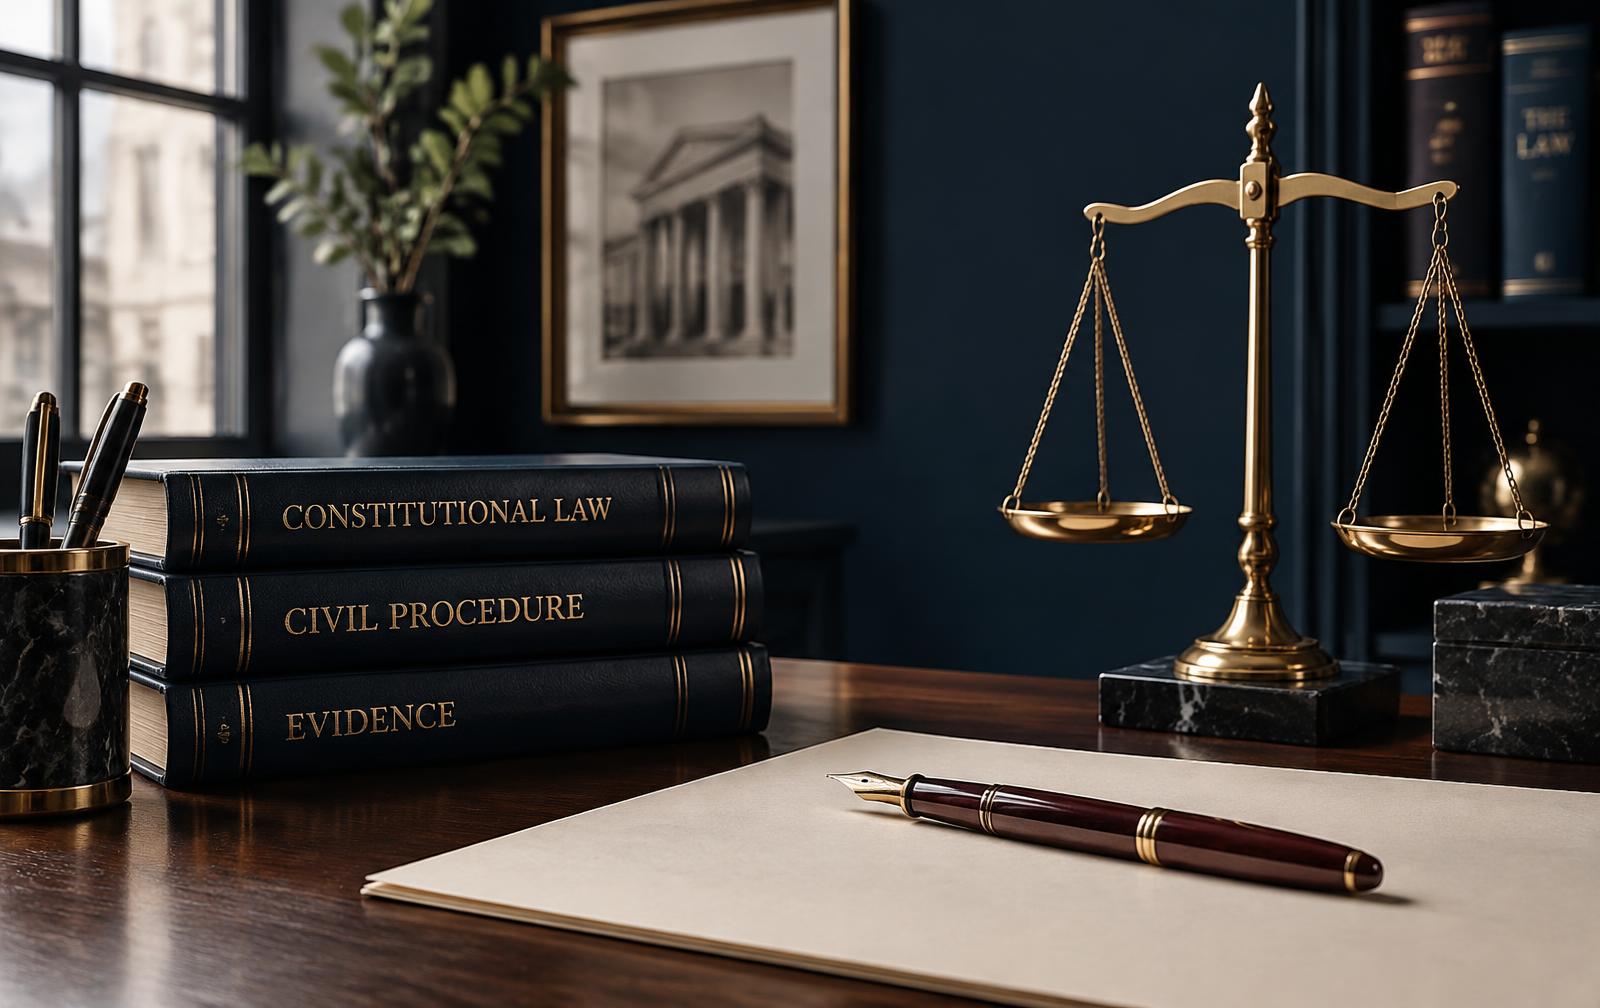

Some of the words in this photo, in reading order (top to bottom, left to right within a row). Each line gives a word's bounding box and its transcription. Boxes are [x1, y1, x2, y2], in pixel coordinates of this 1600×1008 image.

[282, 498, 546, 530] CONSTITUTIONAL
[554, 496, 613, 523] LAW
[284, 604, 378, 635] CIVIL
[389, 593, 584, 630] PROCEDURE
[286, 701, 456, 741] EVIDENCE
